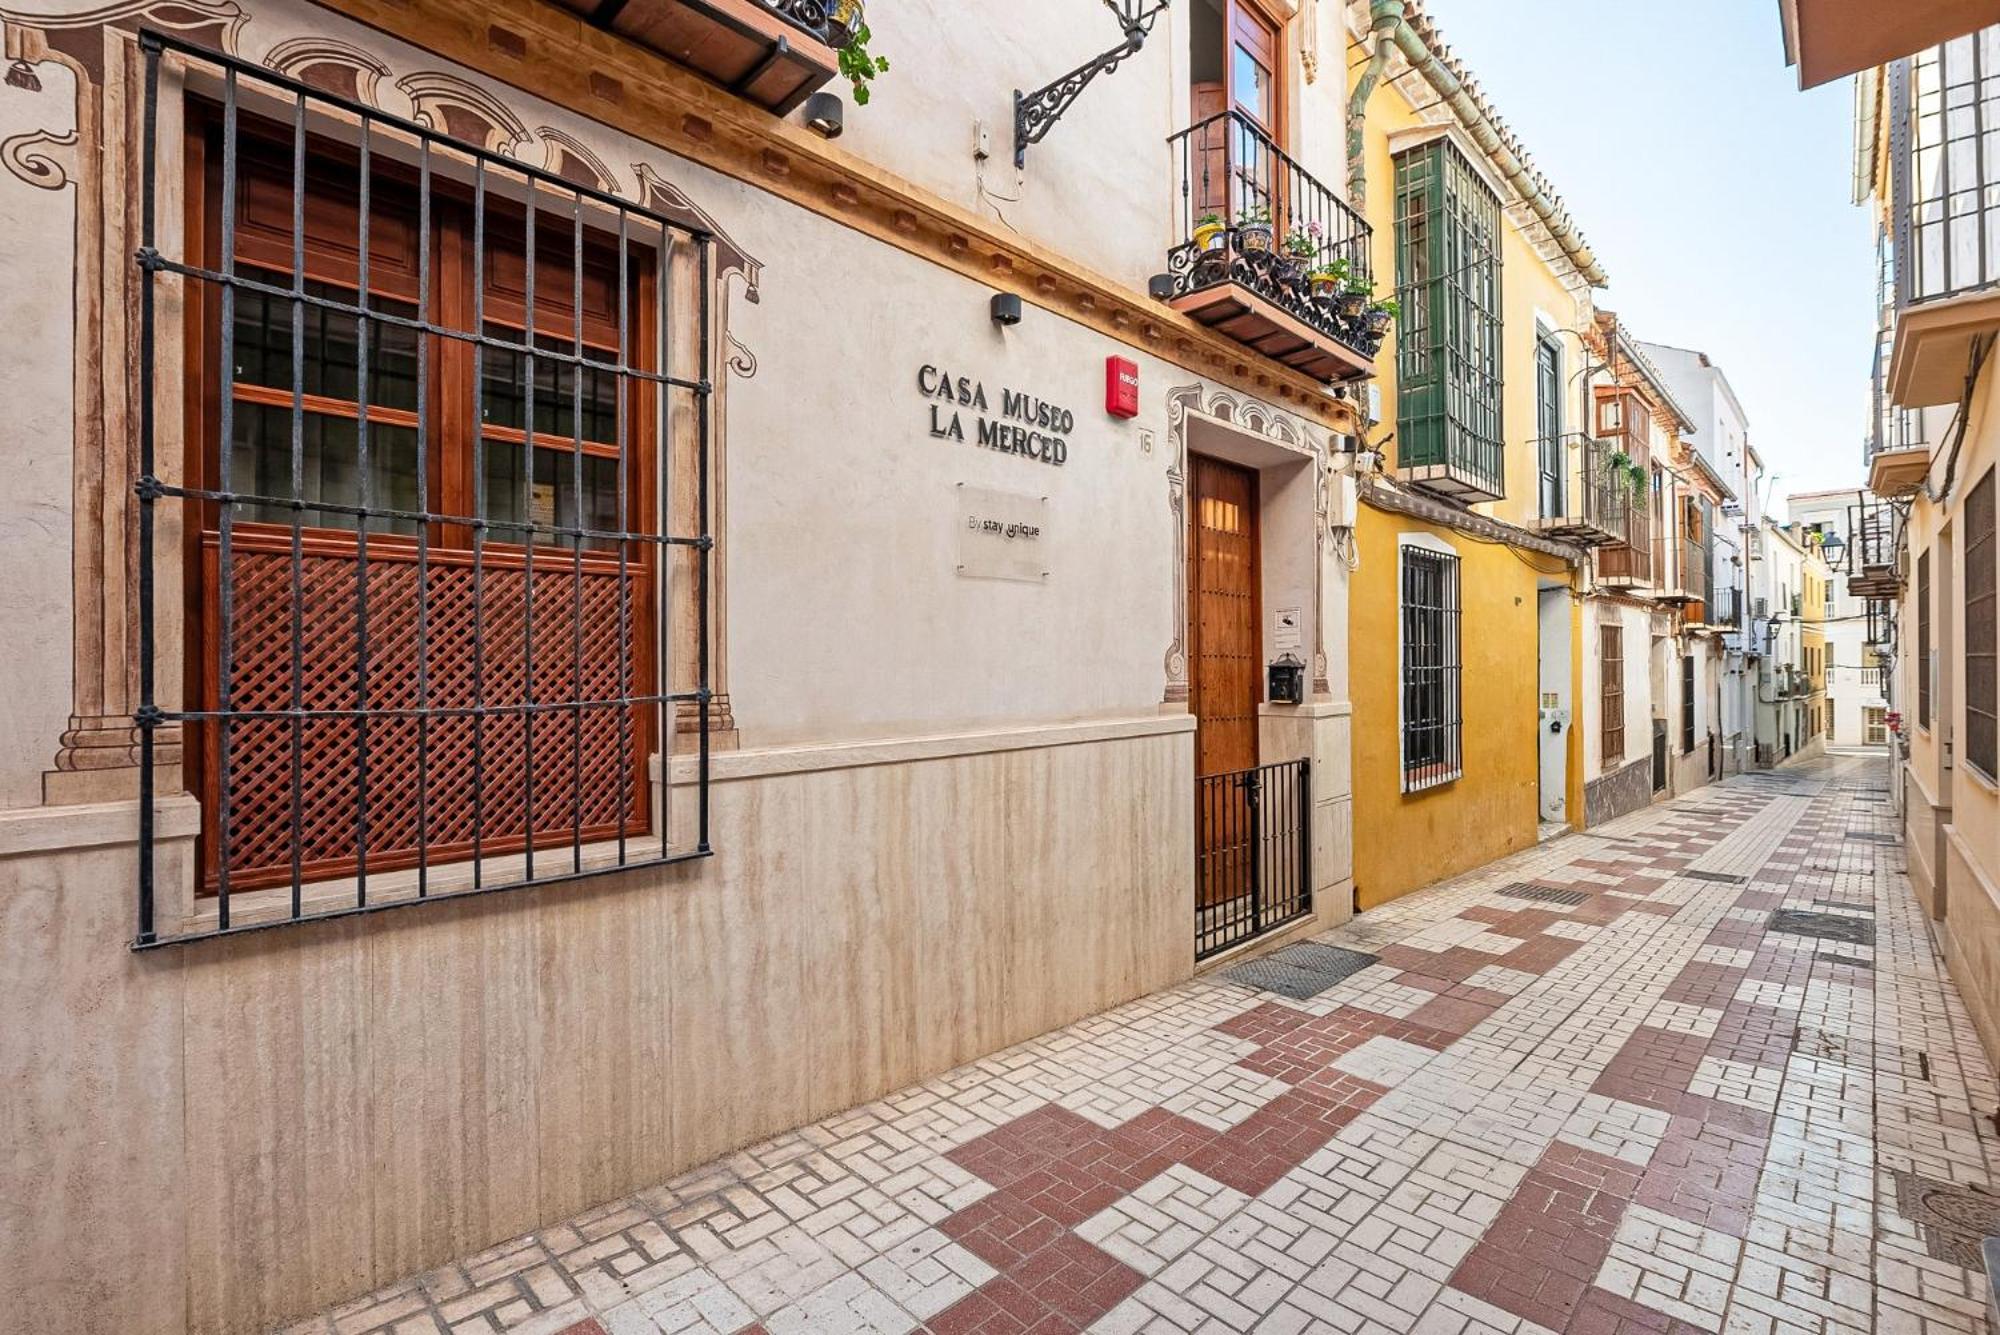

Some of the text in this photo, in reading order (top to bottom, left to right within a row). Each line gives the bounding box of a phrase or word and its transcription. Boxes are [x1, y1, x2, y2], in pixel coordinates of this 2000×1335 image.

[918, 364, 1074, 435] CASA MUSEO
[930, 404, 1067, 466] LA MERCED
[969, 515, 1040, 538] By stay unique
